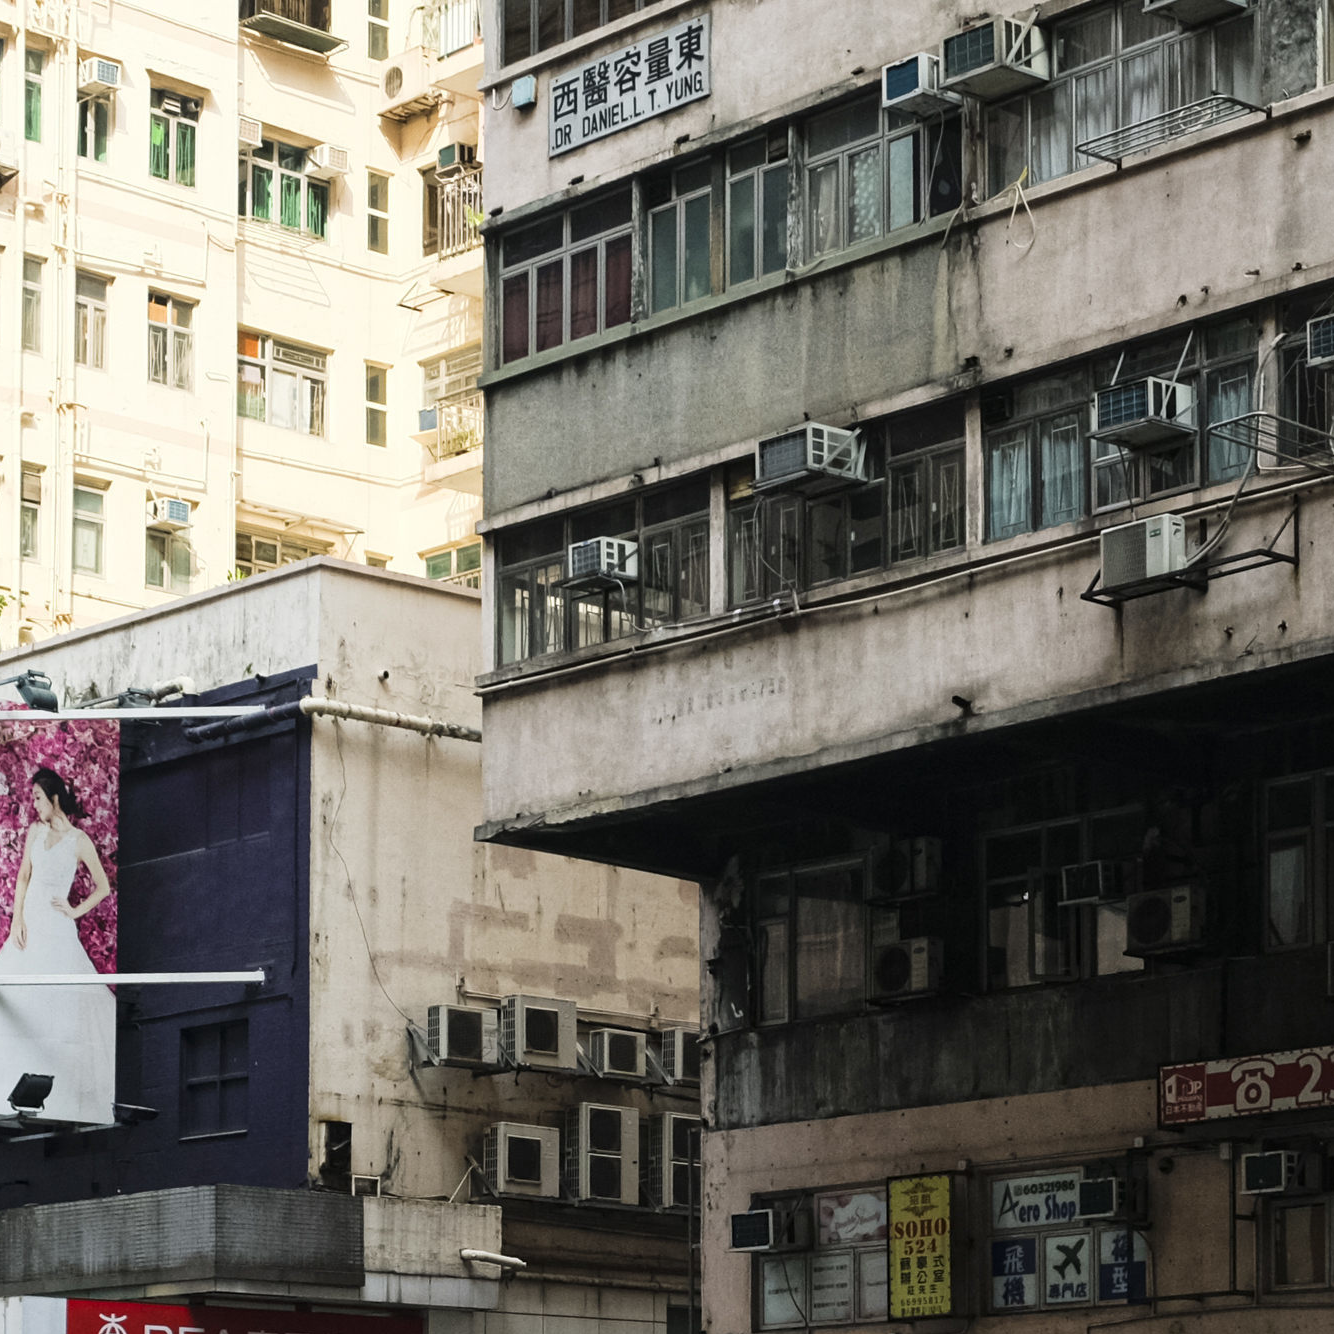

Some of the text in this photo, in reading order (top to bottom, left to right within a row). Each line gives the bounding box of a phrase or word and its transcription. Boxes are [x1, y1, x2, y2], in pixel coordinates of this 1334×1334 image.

[552, 24, 704, 122] 西醫容量東
[666, 71, 703, 104] YUNG
[1023, 1179, 1076, 1195] 60321986
[997, 1183, 1076, 1224] Aero Shop
[893, 1217, 948, 1240] SOHO
[903, 1240, 938, 1256] 524
[1049, 1282, 1087, 1299] 專門店
